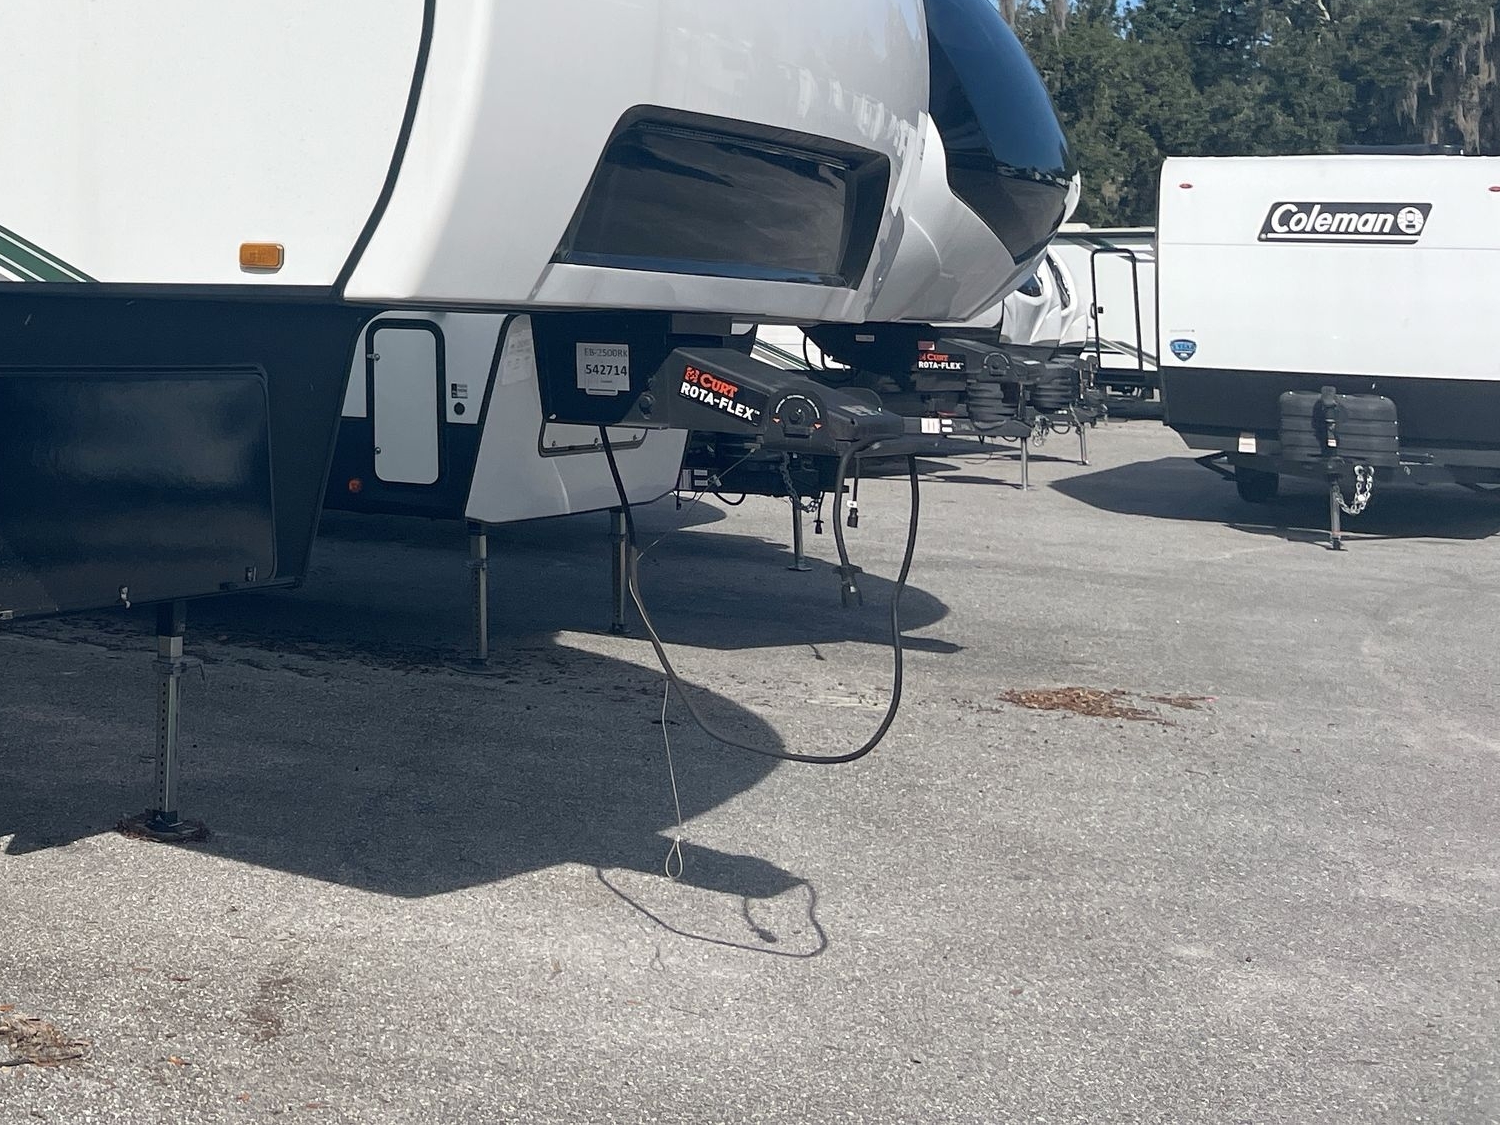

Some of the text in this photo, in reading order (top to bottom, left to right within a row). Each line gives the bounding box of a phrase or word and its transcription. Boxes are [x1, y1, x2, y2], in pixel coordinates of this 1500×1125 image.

[1270, 203, 1395, 233] Coleman
[585, 363, 628, 376] 542714
[700, 371, 739, 398] CURT
